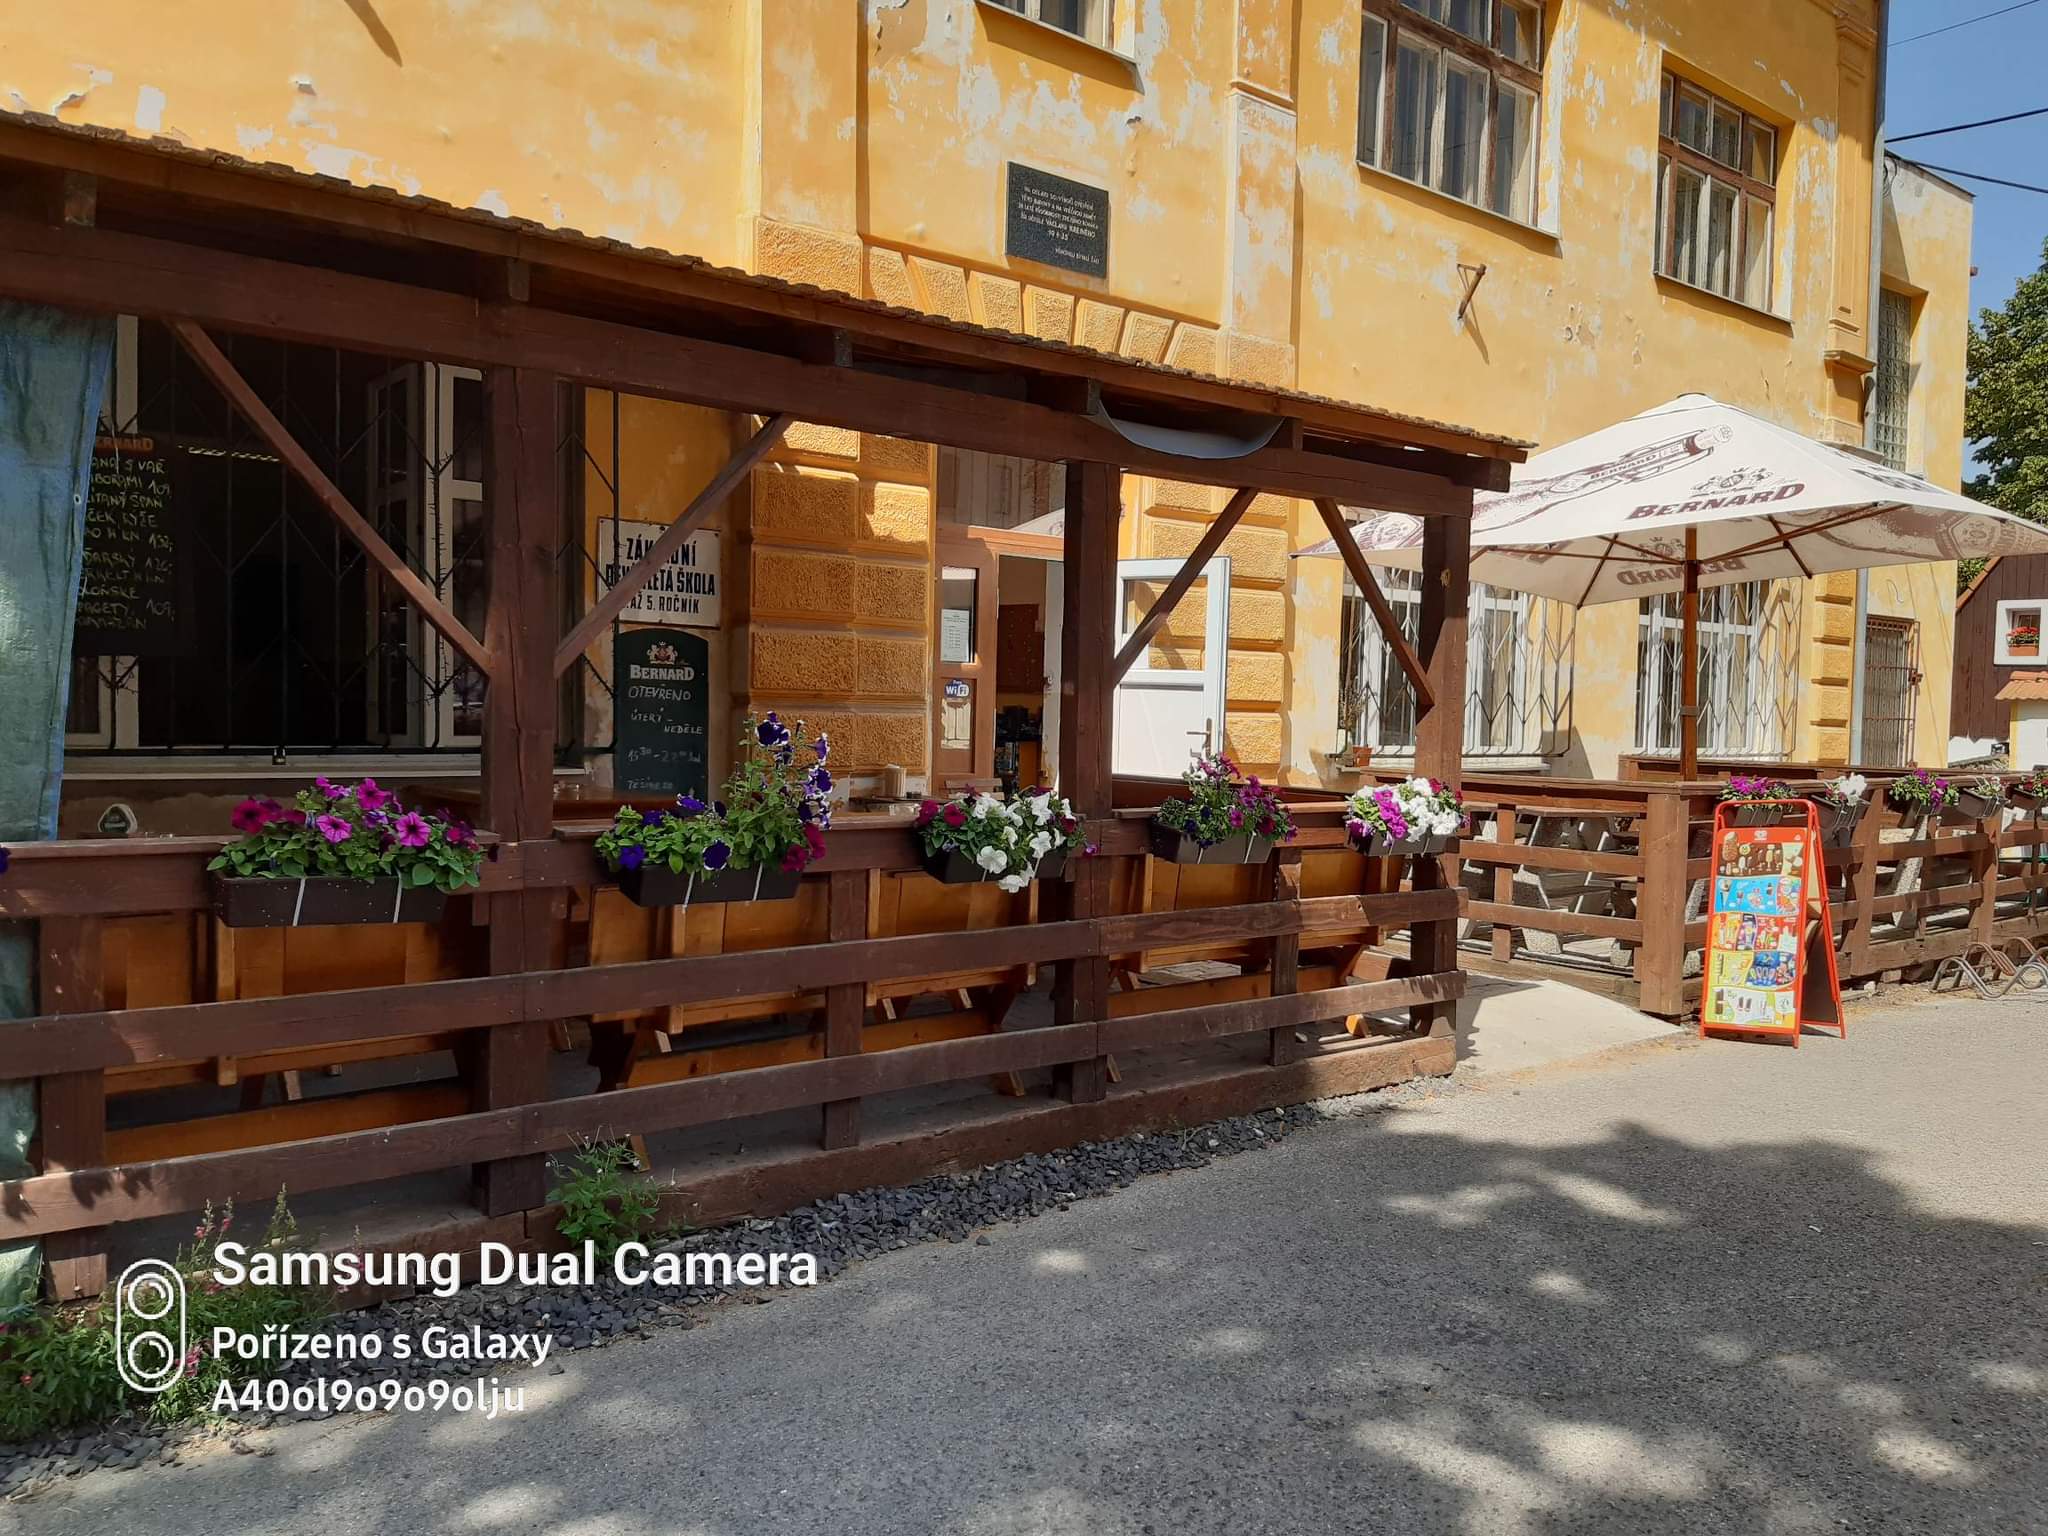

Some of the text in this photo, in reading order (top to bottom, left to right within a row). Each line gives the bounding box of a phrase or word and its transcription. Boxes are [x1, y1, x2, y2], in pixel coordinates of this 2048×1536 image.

[1627, 483, 1805, 520] BERNARD
[626, 533, 697, 567] ZÁKDNÍ
[606, 562, 715, 595] DELETÁ ŠKOLA
[647, 595, 656, 610] 5.
[659, 594, 699, 614] ROČNÍK
[630, 664, 695, 681] BERNARD
[628, 683, 691, 701] OTEVŘENO
[945, 685, 970, 698] WiFi
[664, 723, 703, 735] NEDĚLE
